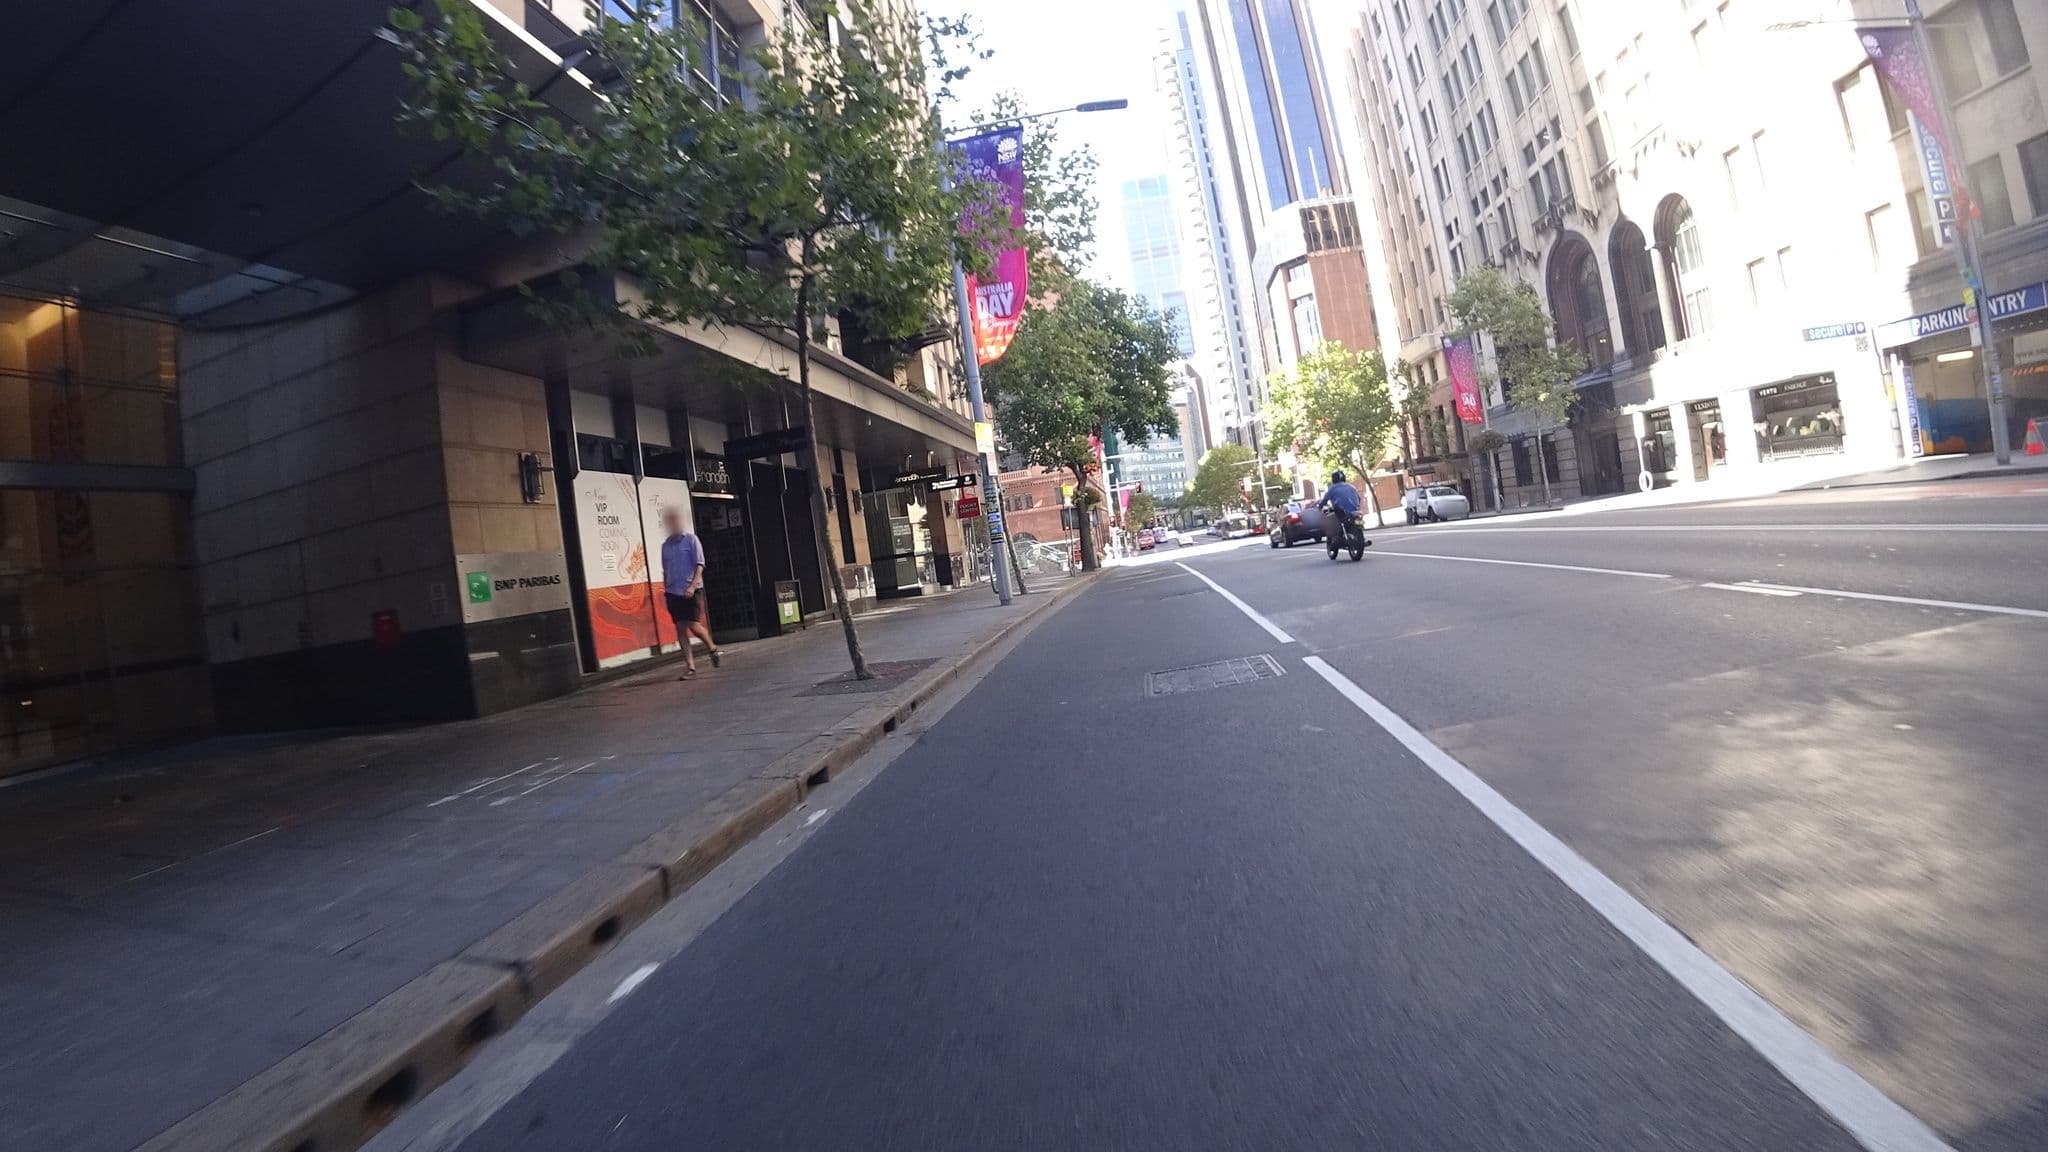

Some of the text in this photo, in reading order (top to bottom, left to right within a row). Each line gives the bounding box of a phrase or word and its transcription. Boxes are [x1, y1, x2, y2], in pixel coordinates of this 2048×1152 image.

[998, 150, 1017, 164] NSW
[975, 281, 1013, 298] AUSTRALIA
[976, 292, 1013, 320] DAY
[1987, 290, 2026, 316] NTRY
[1808, 324, 1844, 340] secure
[1759, 387, 1778, 397] VERTU
[595, 503, 608, 512] VIP
[597, 516, 620, 525] ROOM
[600, 528, 627, 538] COMING
[601, 541, 619, 551] SOON
[495, 575, 561, 591] BNP PARIBAS
